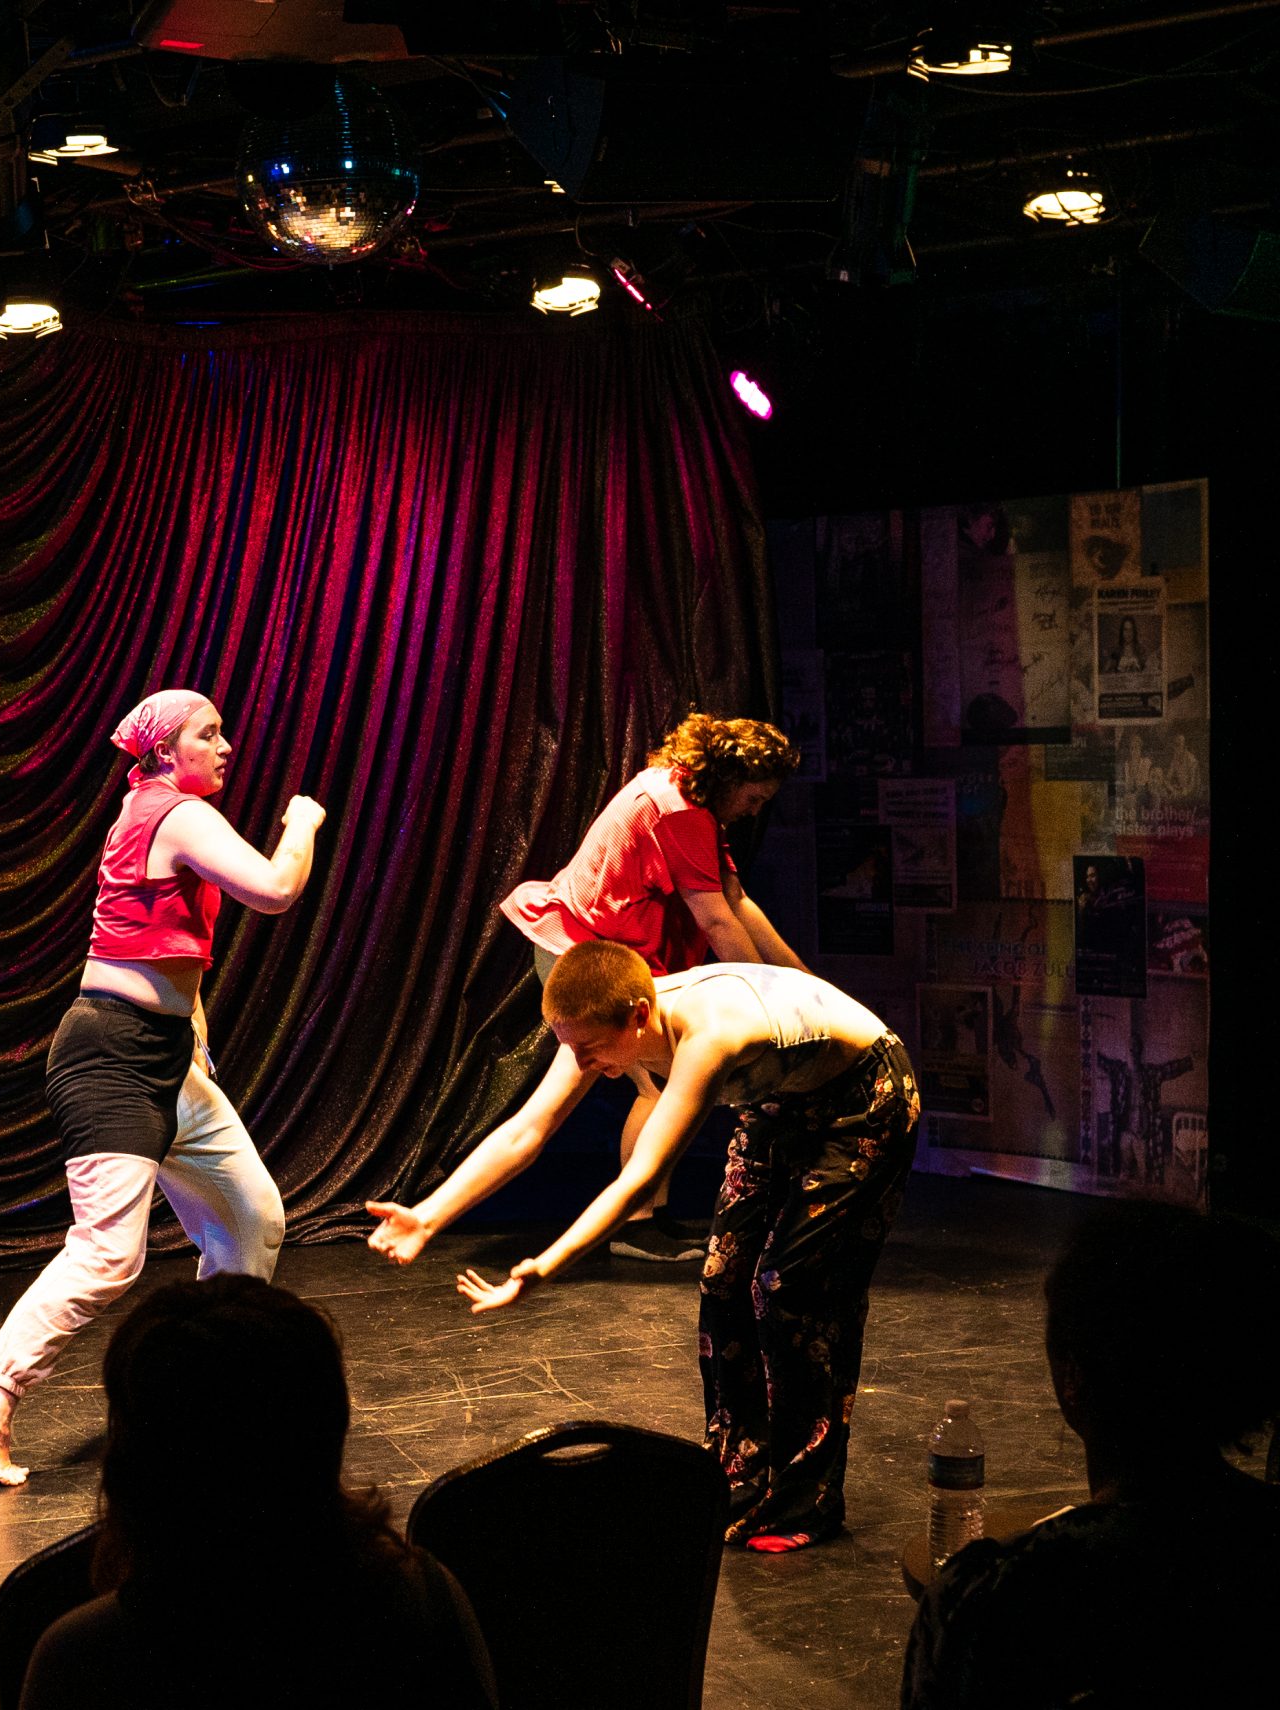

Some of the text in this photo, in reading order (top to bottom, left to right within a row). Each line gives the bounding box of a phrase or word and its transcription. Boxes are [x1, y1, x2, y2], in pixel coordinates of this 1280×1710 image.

[1115, 805, 1136, 820] the
[1115, 821, 1194, 840] sister plays
